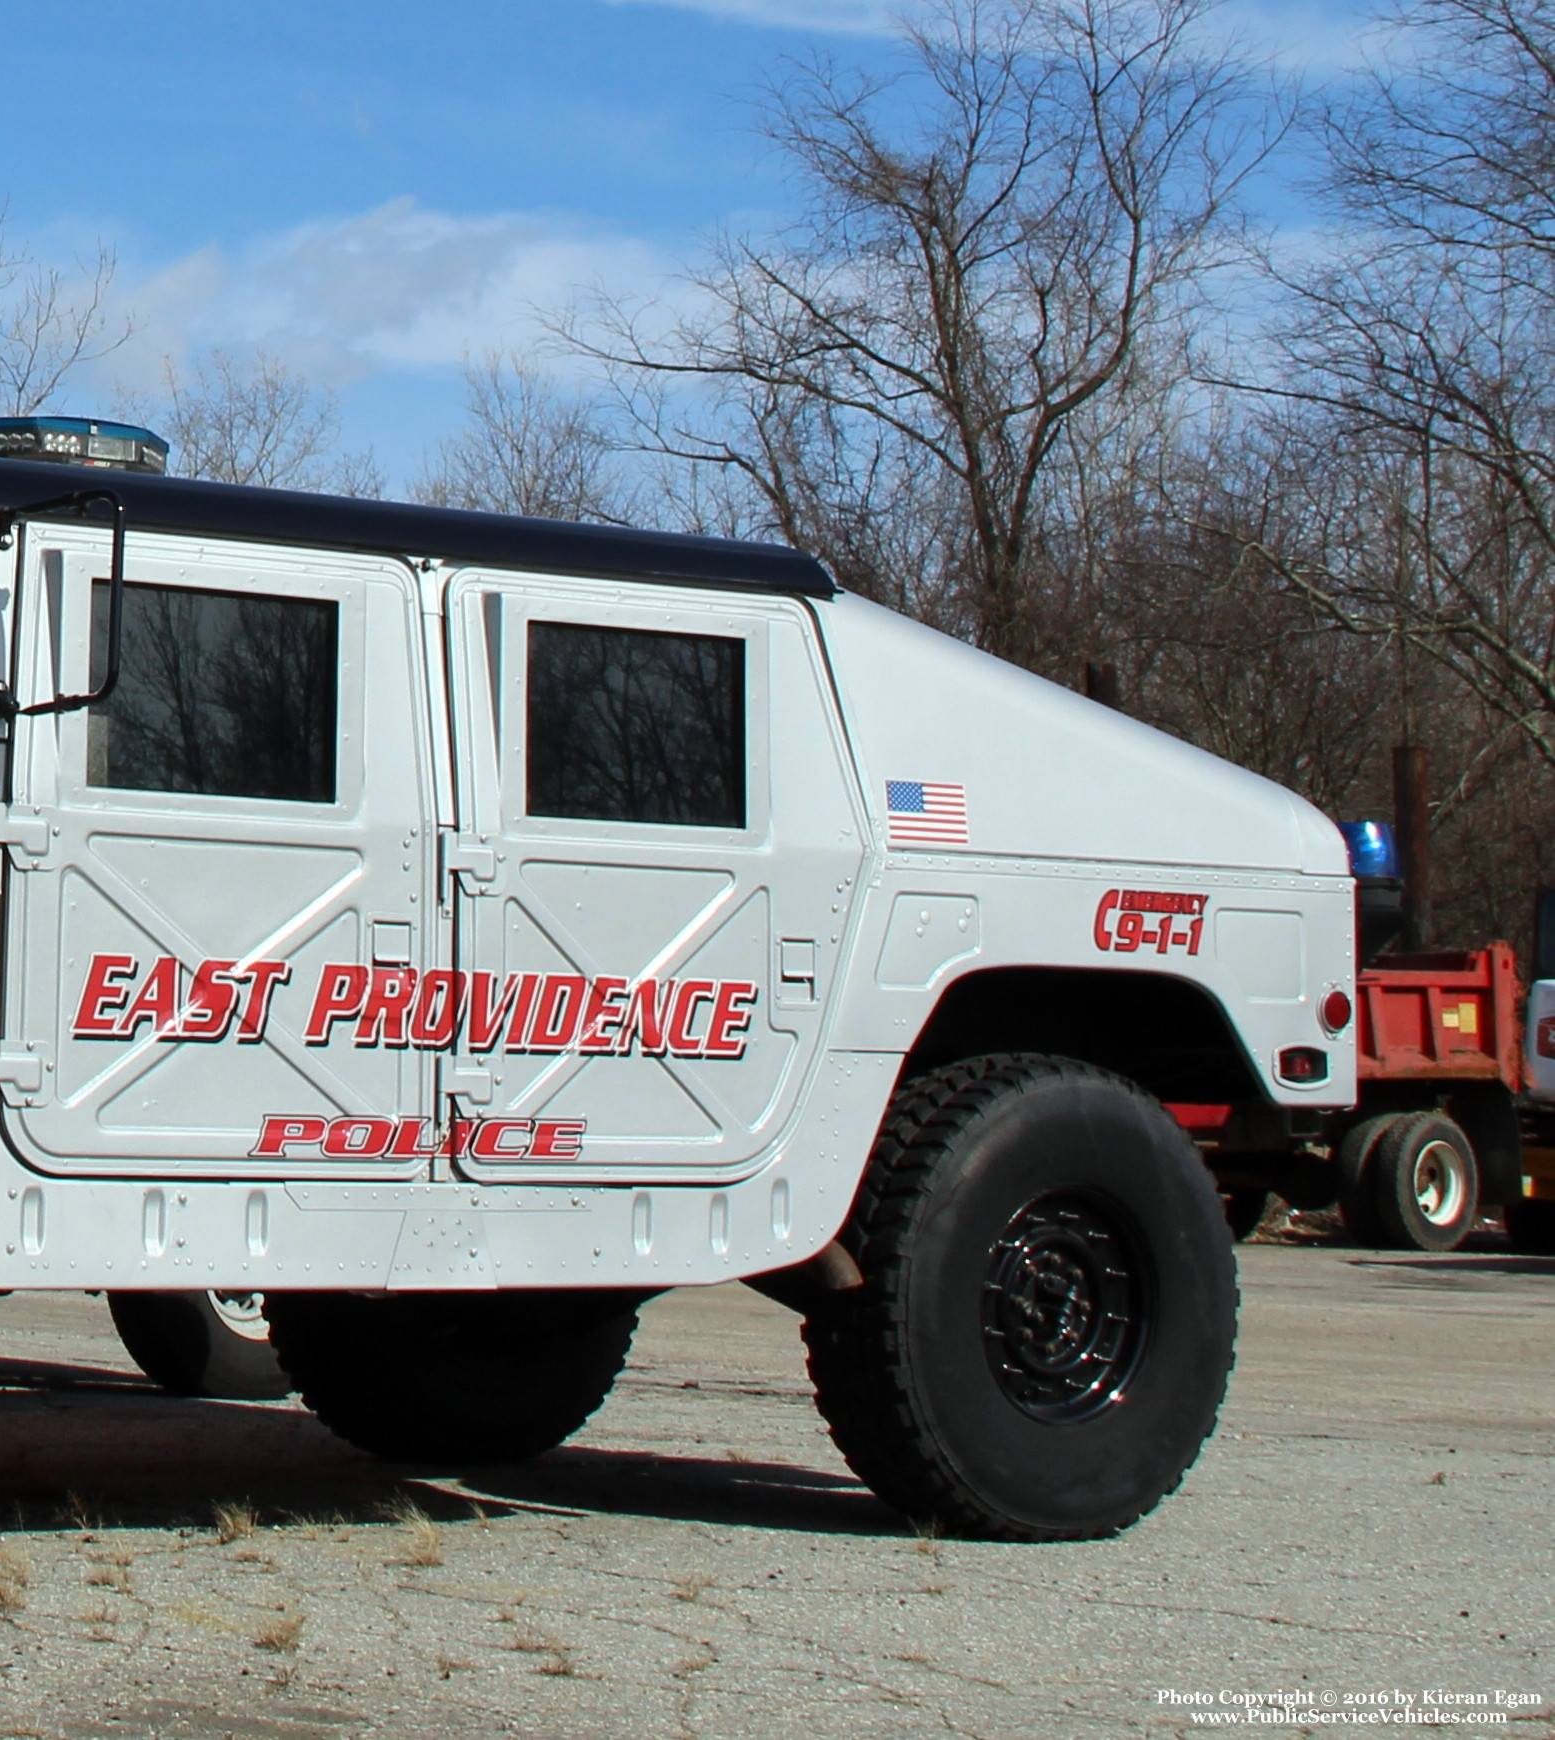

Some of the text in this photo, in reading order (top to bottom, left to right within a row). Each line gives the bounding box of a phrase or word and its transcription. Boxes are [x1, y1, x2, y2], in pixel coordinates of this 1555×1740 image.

[1114, 913, 1203, 955] 9-1-1
[68, 953, 757, 1059] EAST PROVIDENCE
[247, 1114, 587, 1160] POLICE
